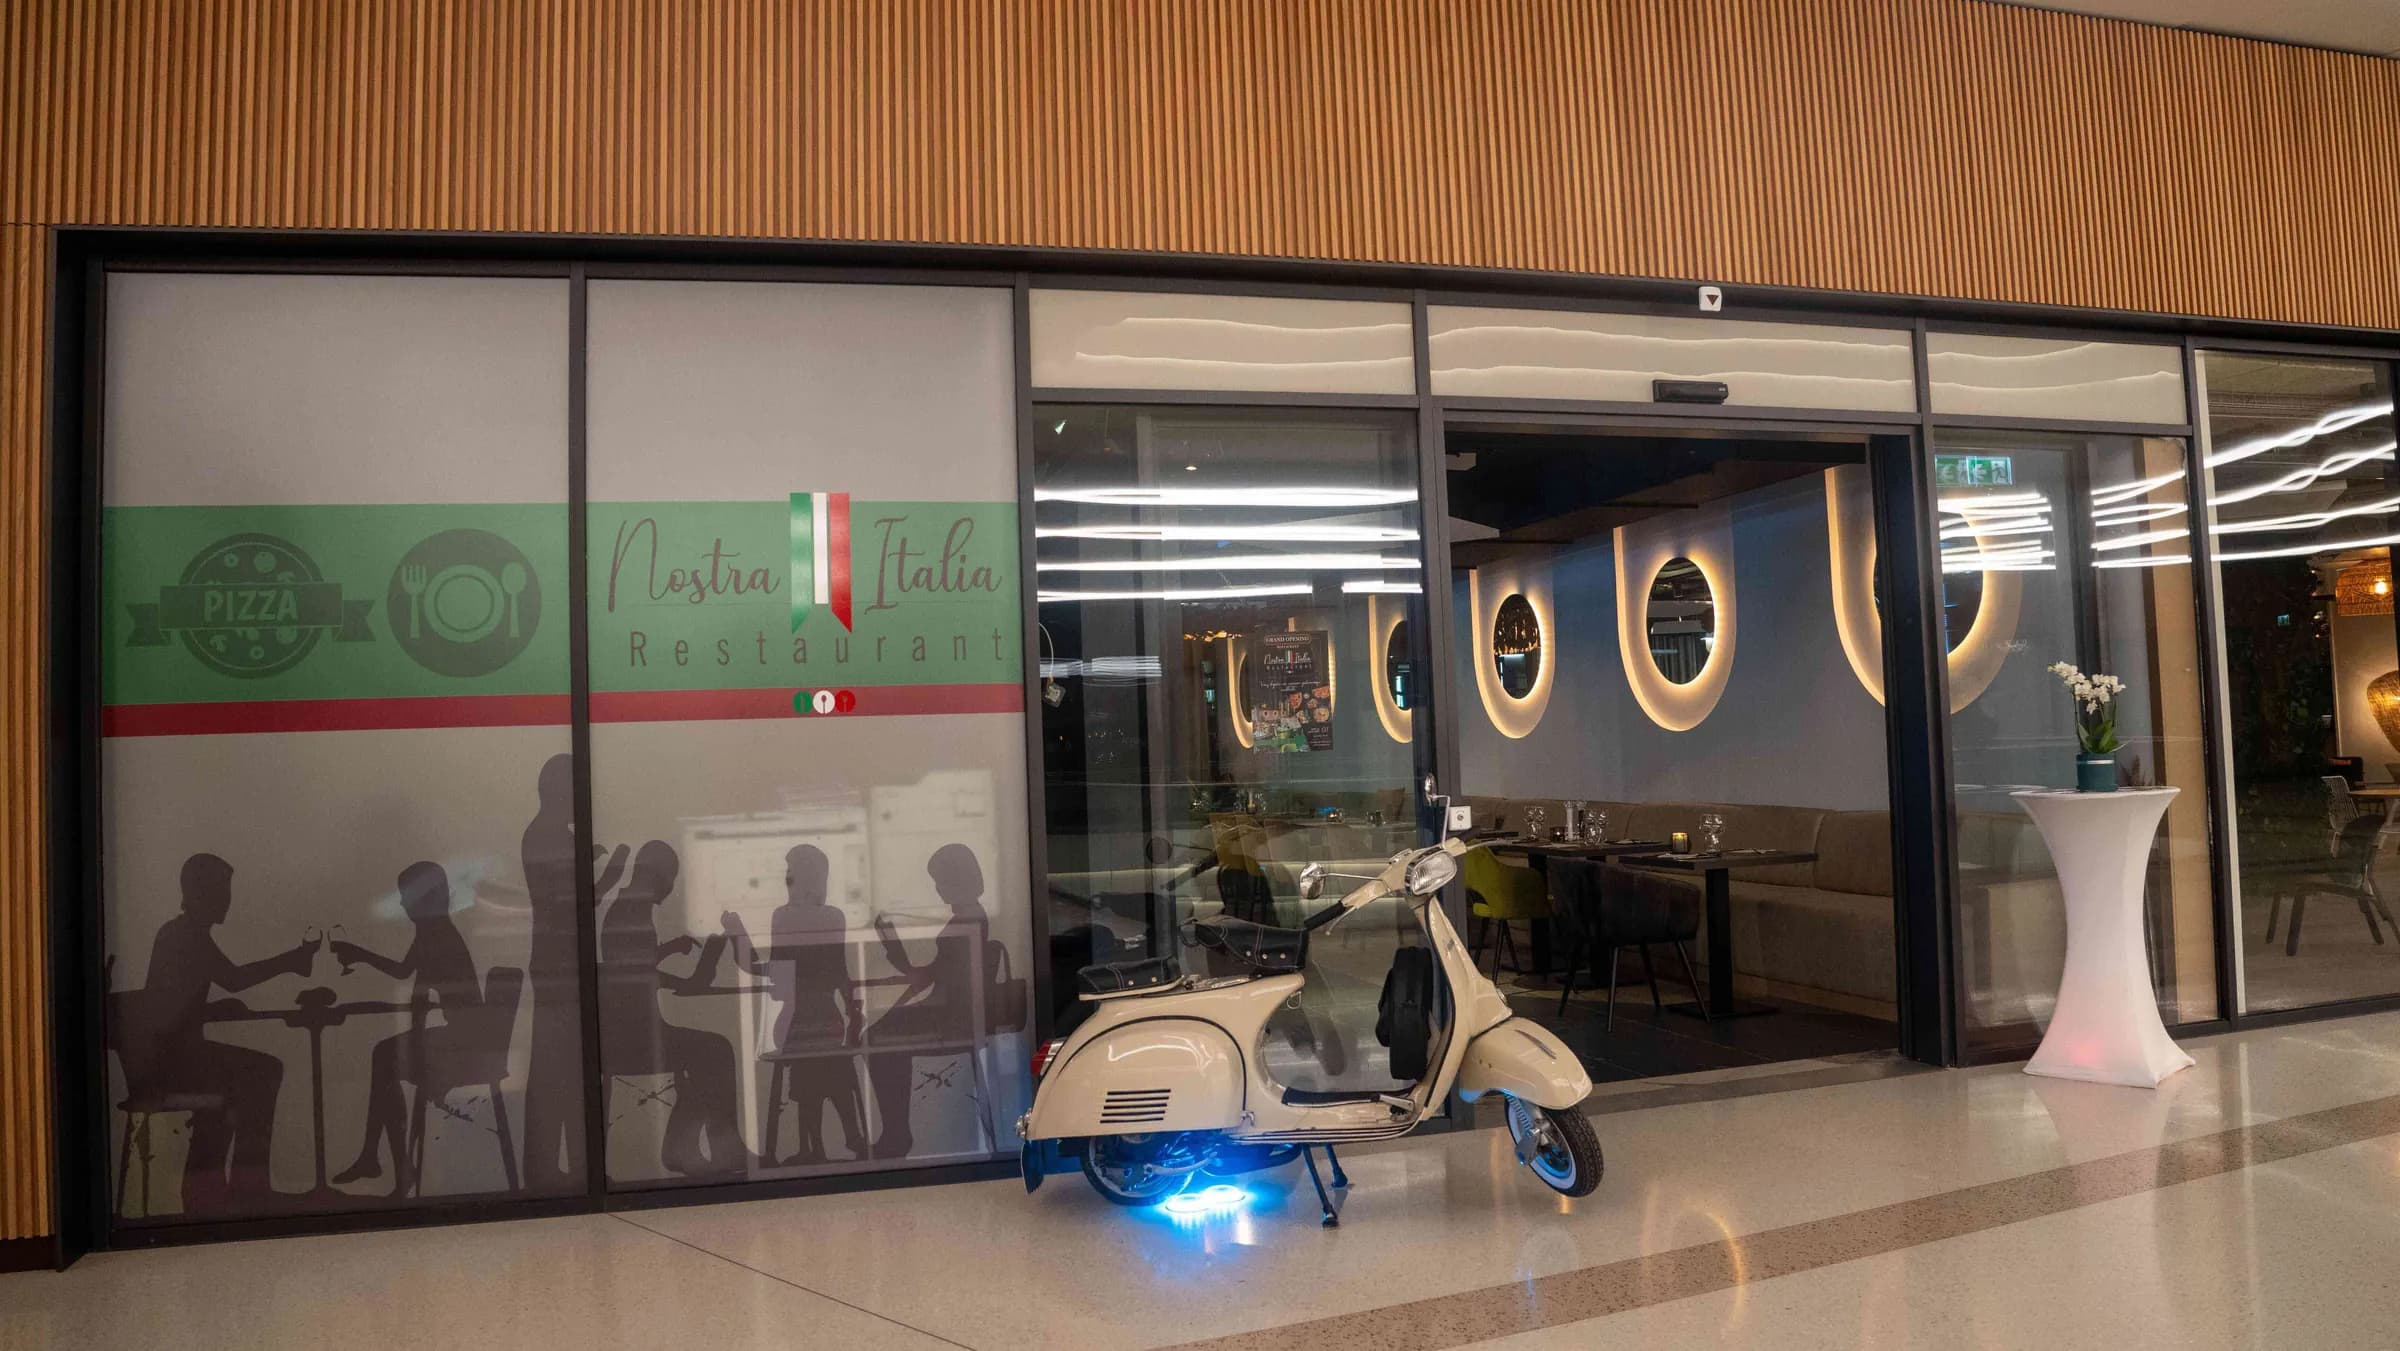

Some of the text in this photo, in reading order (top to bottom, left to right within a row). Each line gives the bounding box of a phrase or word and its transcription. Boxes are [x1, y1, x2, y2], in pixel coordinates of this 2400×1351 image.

[607, 514, 1002, 616] Nostra Italia
[203, 589, 299, 623] PIZZA
[629, 627, 1003, 667] Restaurant
